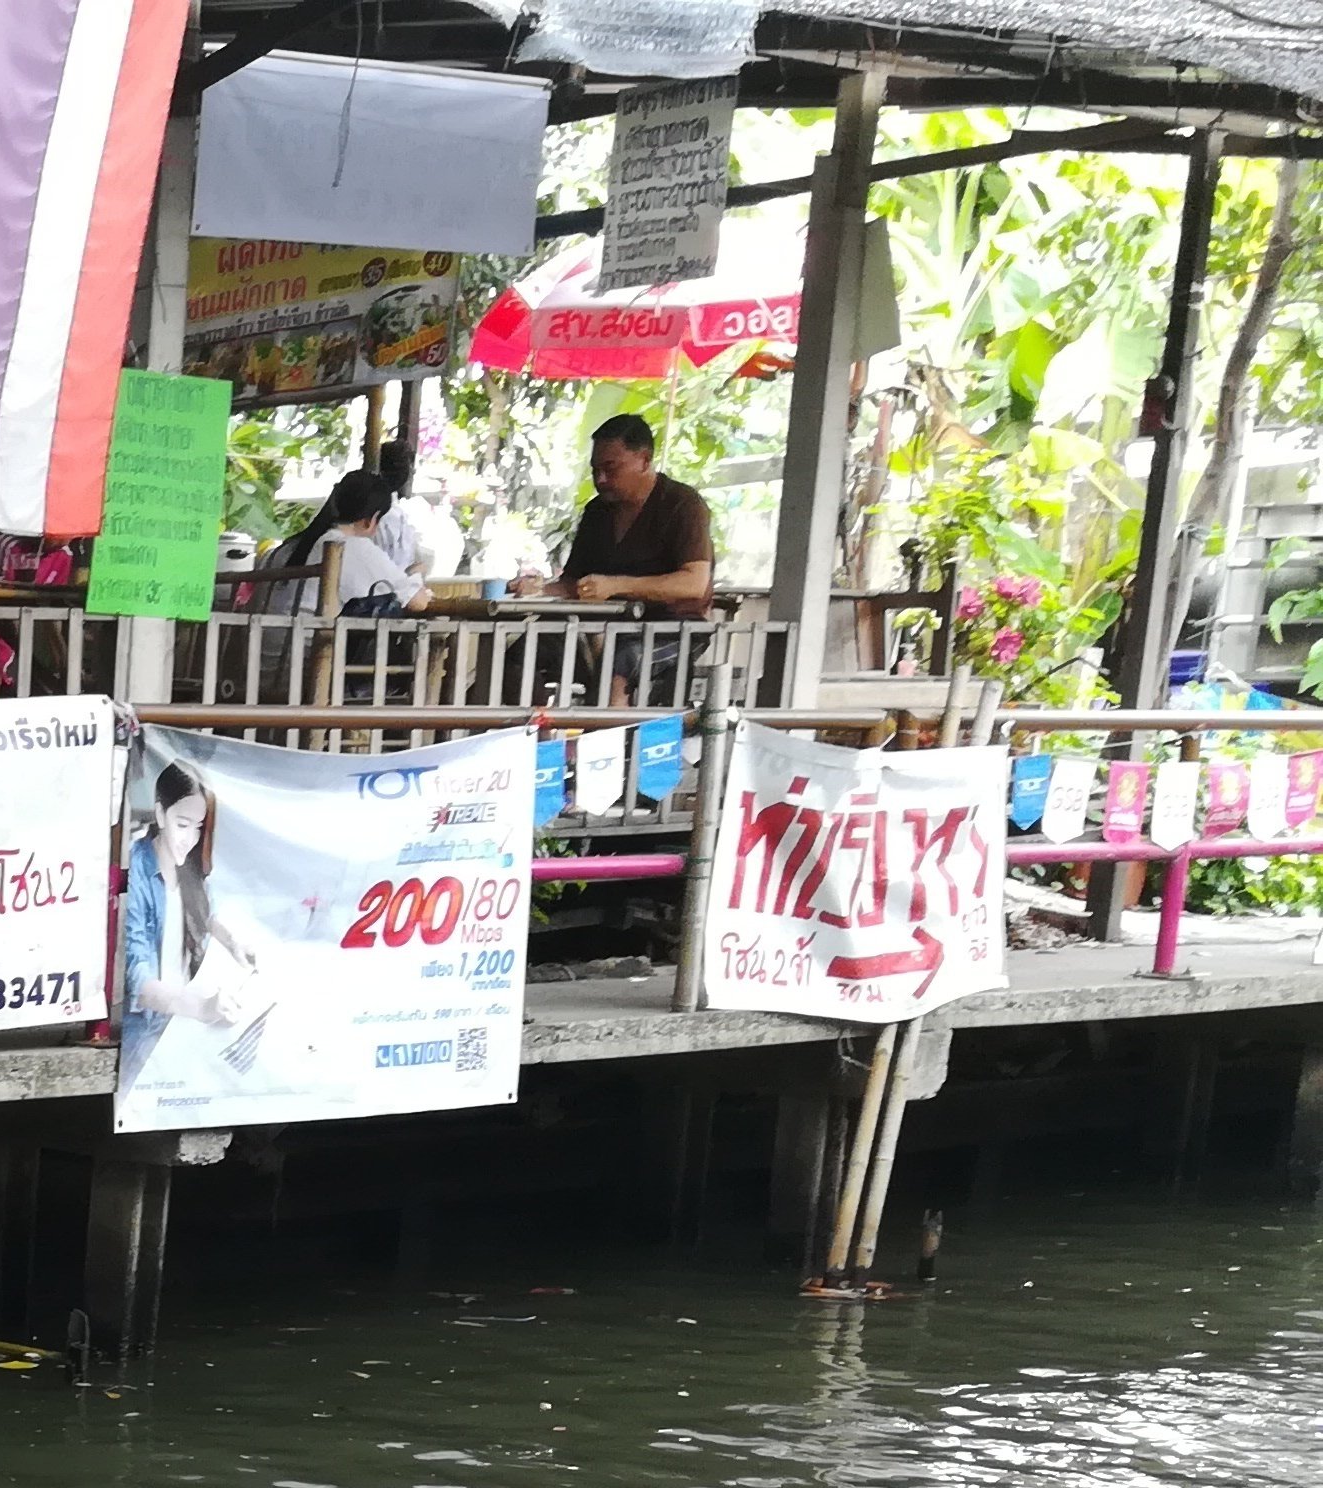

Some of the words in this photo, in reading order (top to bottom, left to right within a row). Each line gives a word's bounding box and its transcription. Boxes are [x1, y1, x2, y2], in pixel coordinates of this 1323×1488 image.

[642, 741, 679, 761] TOT
[347, 765, 439, 801] TOT
[460, 923, 503, 947] Mbps
[457, 949, 515, 981] 1,200
